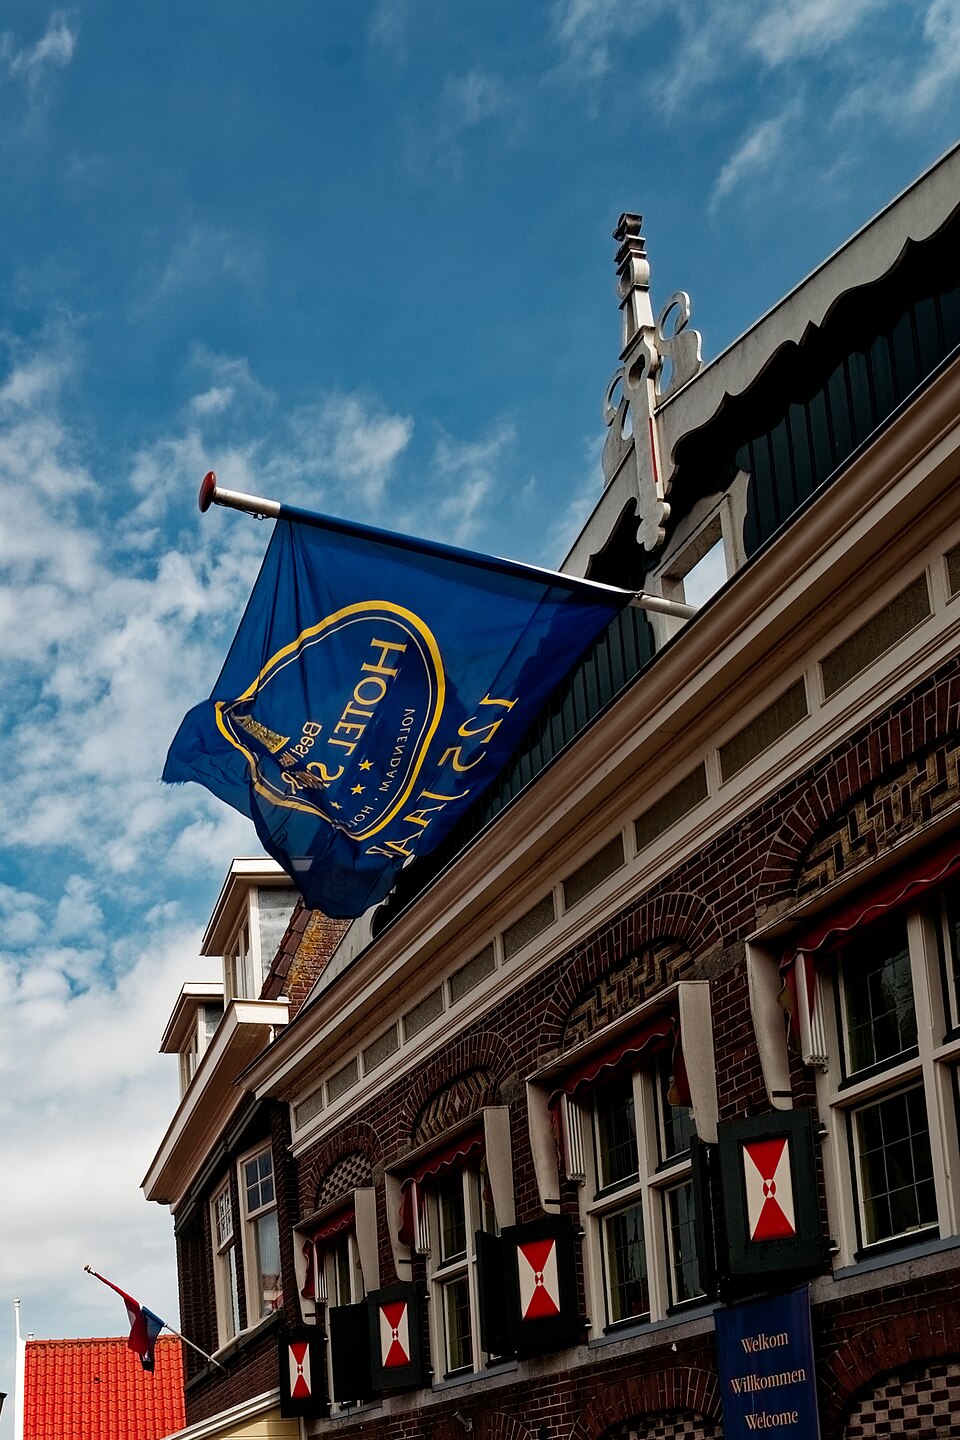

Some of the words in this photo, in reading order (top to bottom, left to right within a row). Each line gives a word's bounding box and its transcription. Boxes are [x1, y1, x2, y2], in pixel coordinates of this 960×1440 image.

[741, 1332, 789, 1354] Welkom
[730, 1368, 806, 1395] Willkommen
[744, 1410, 799, 1431] Welcome
